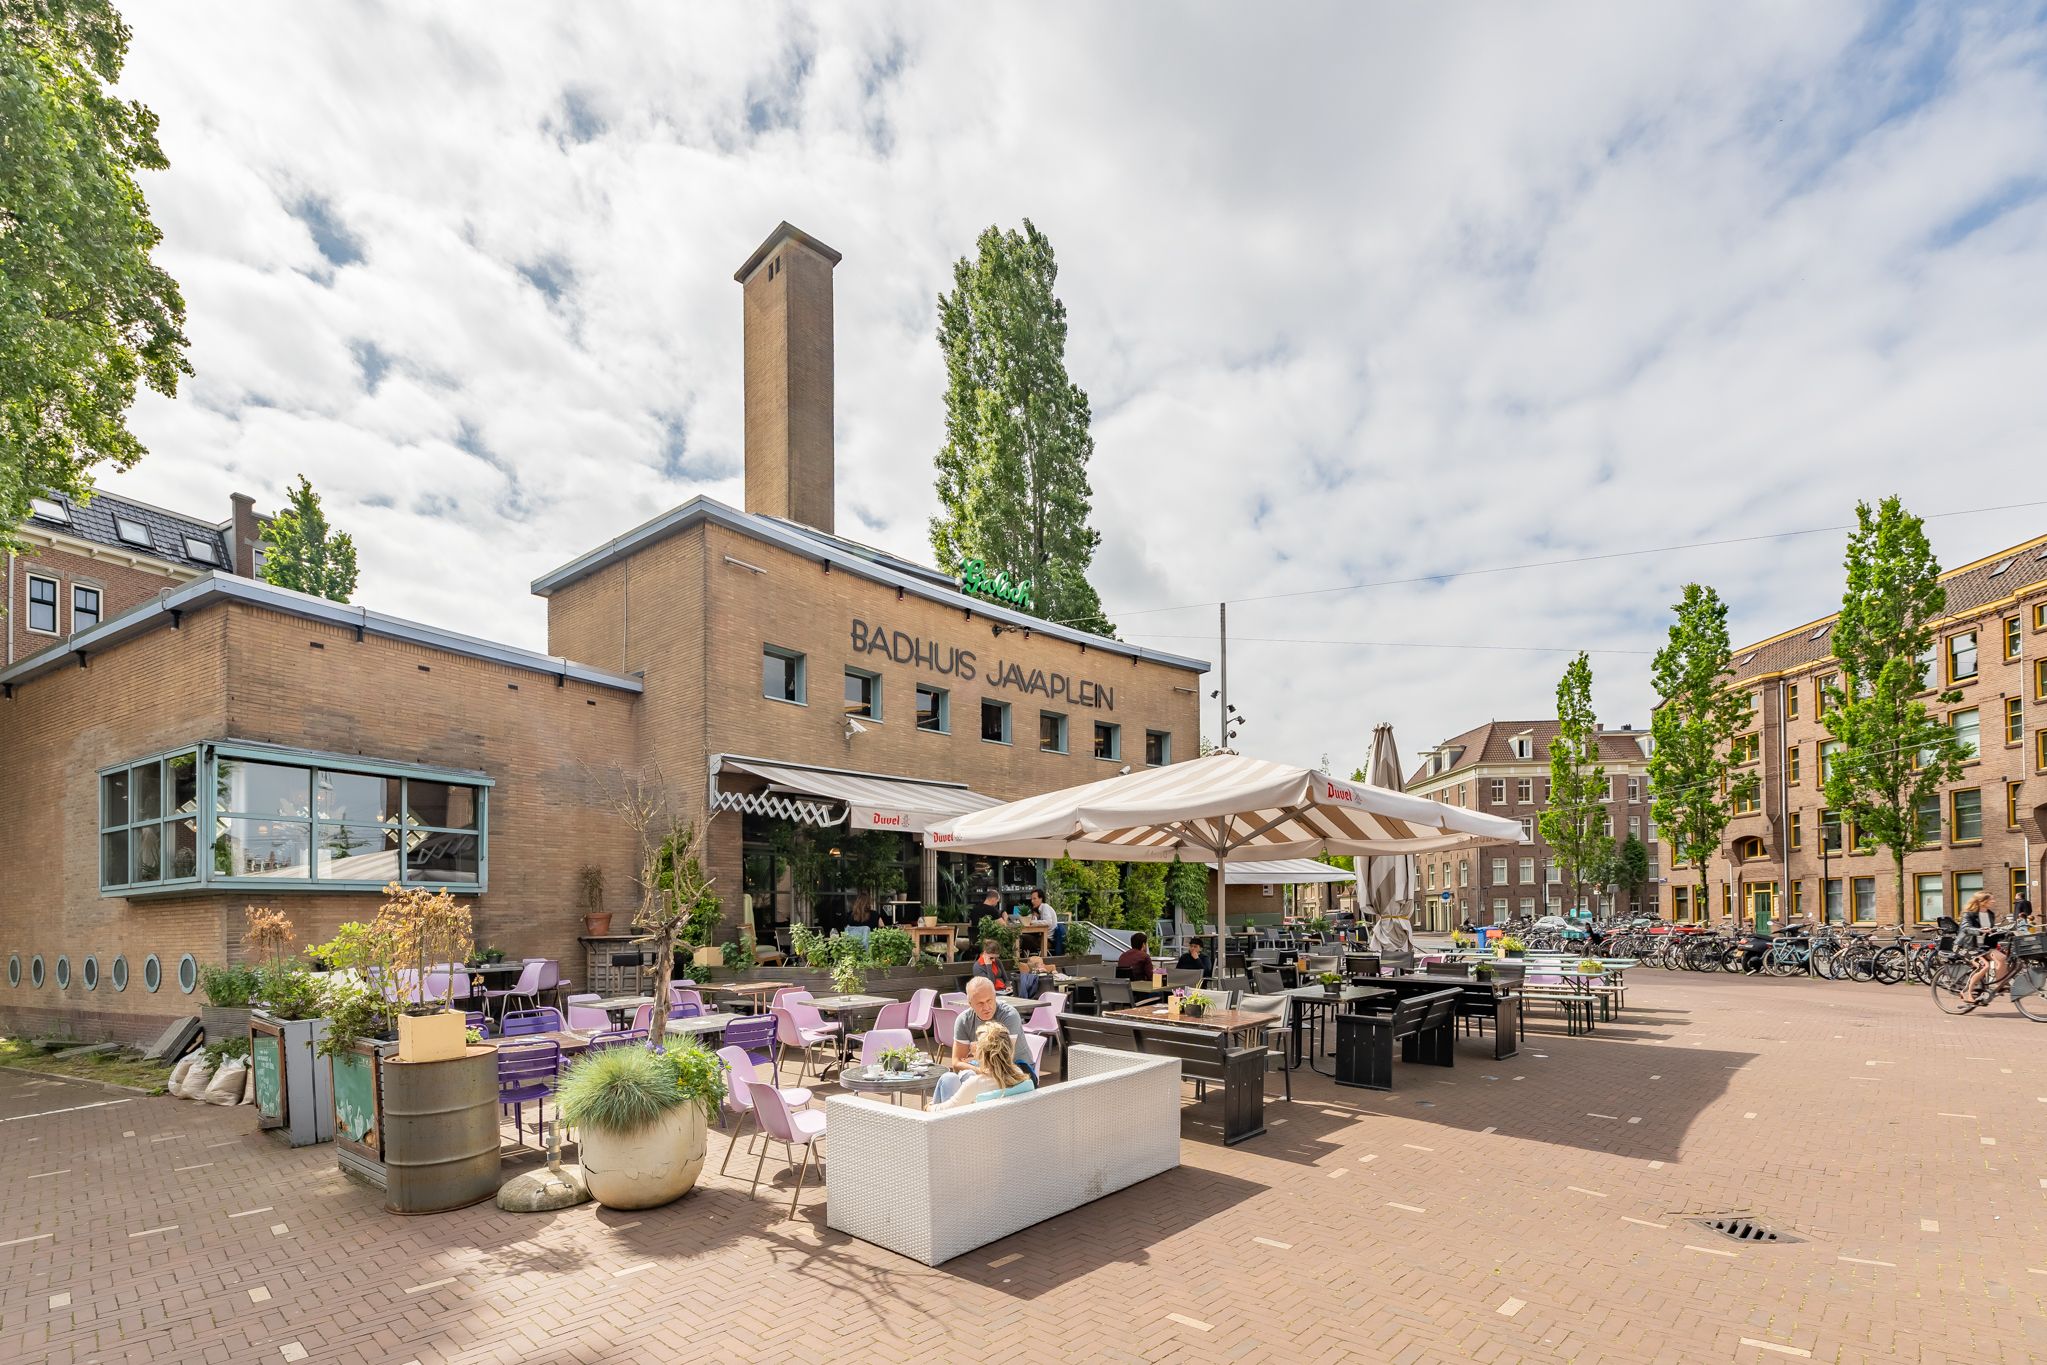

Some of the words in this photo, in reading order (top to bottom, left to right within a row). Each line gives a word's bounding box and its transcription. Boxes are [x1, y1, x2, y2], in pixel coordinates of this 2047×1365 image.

[962, 559, 1031, 607] Grolsch
[851, 618, 977, 681] BADHUIS
[985, 659, 1114, 711] JAVAPLEIN
[1327, 782, 1353, 801] Duvel
[873, 812, 900, 825] Duvel
[933, 832, 954, 843] Duvel
